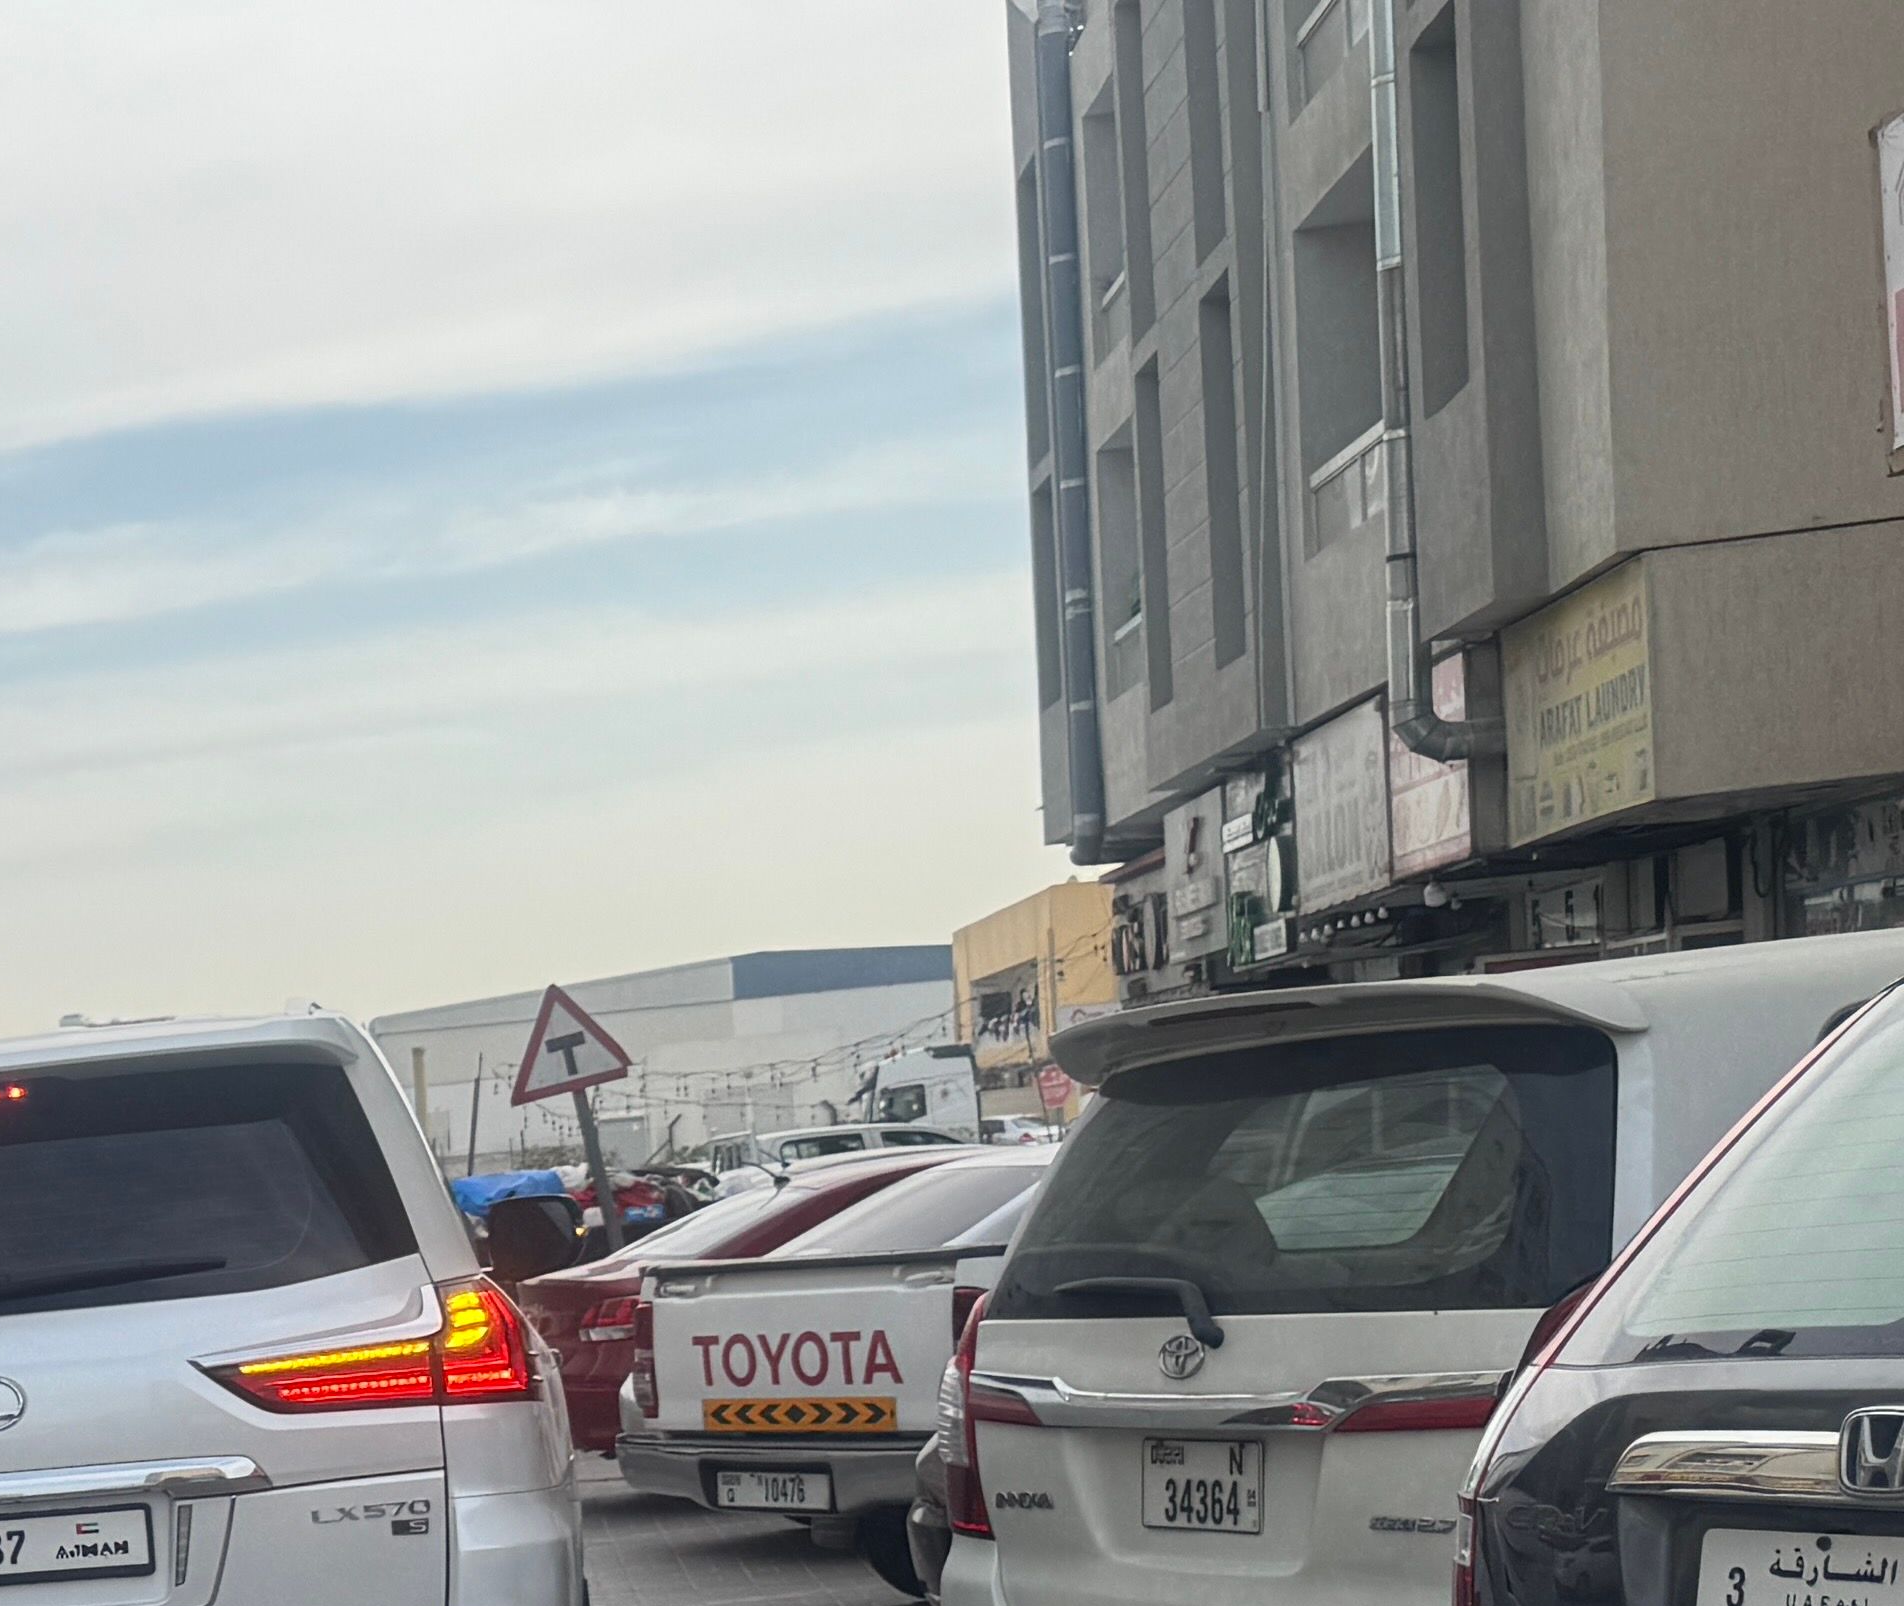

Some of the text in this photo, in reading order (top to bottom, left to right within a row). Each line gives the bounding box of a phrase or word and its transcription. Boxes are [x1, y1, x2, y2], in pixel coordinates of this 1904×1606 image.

[1541, 694, 1583, 751] ARAFAT
[1587, 664, 1646, 728] LAUNDRY
[692, 1330, 904, 1388] TOYOTA
[1229, 1446, 1244, 1475] N
[763, 1478, 806, 1503] 10476
[1164, 1478, 1240, 1525] 34364
[409, 1520, 427, 1533] S
[1769, 1547, 1899, 1587] الشارقة
